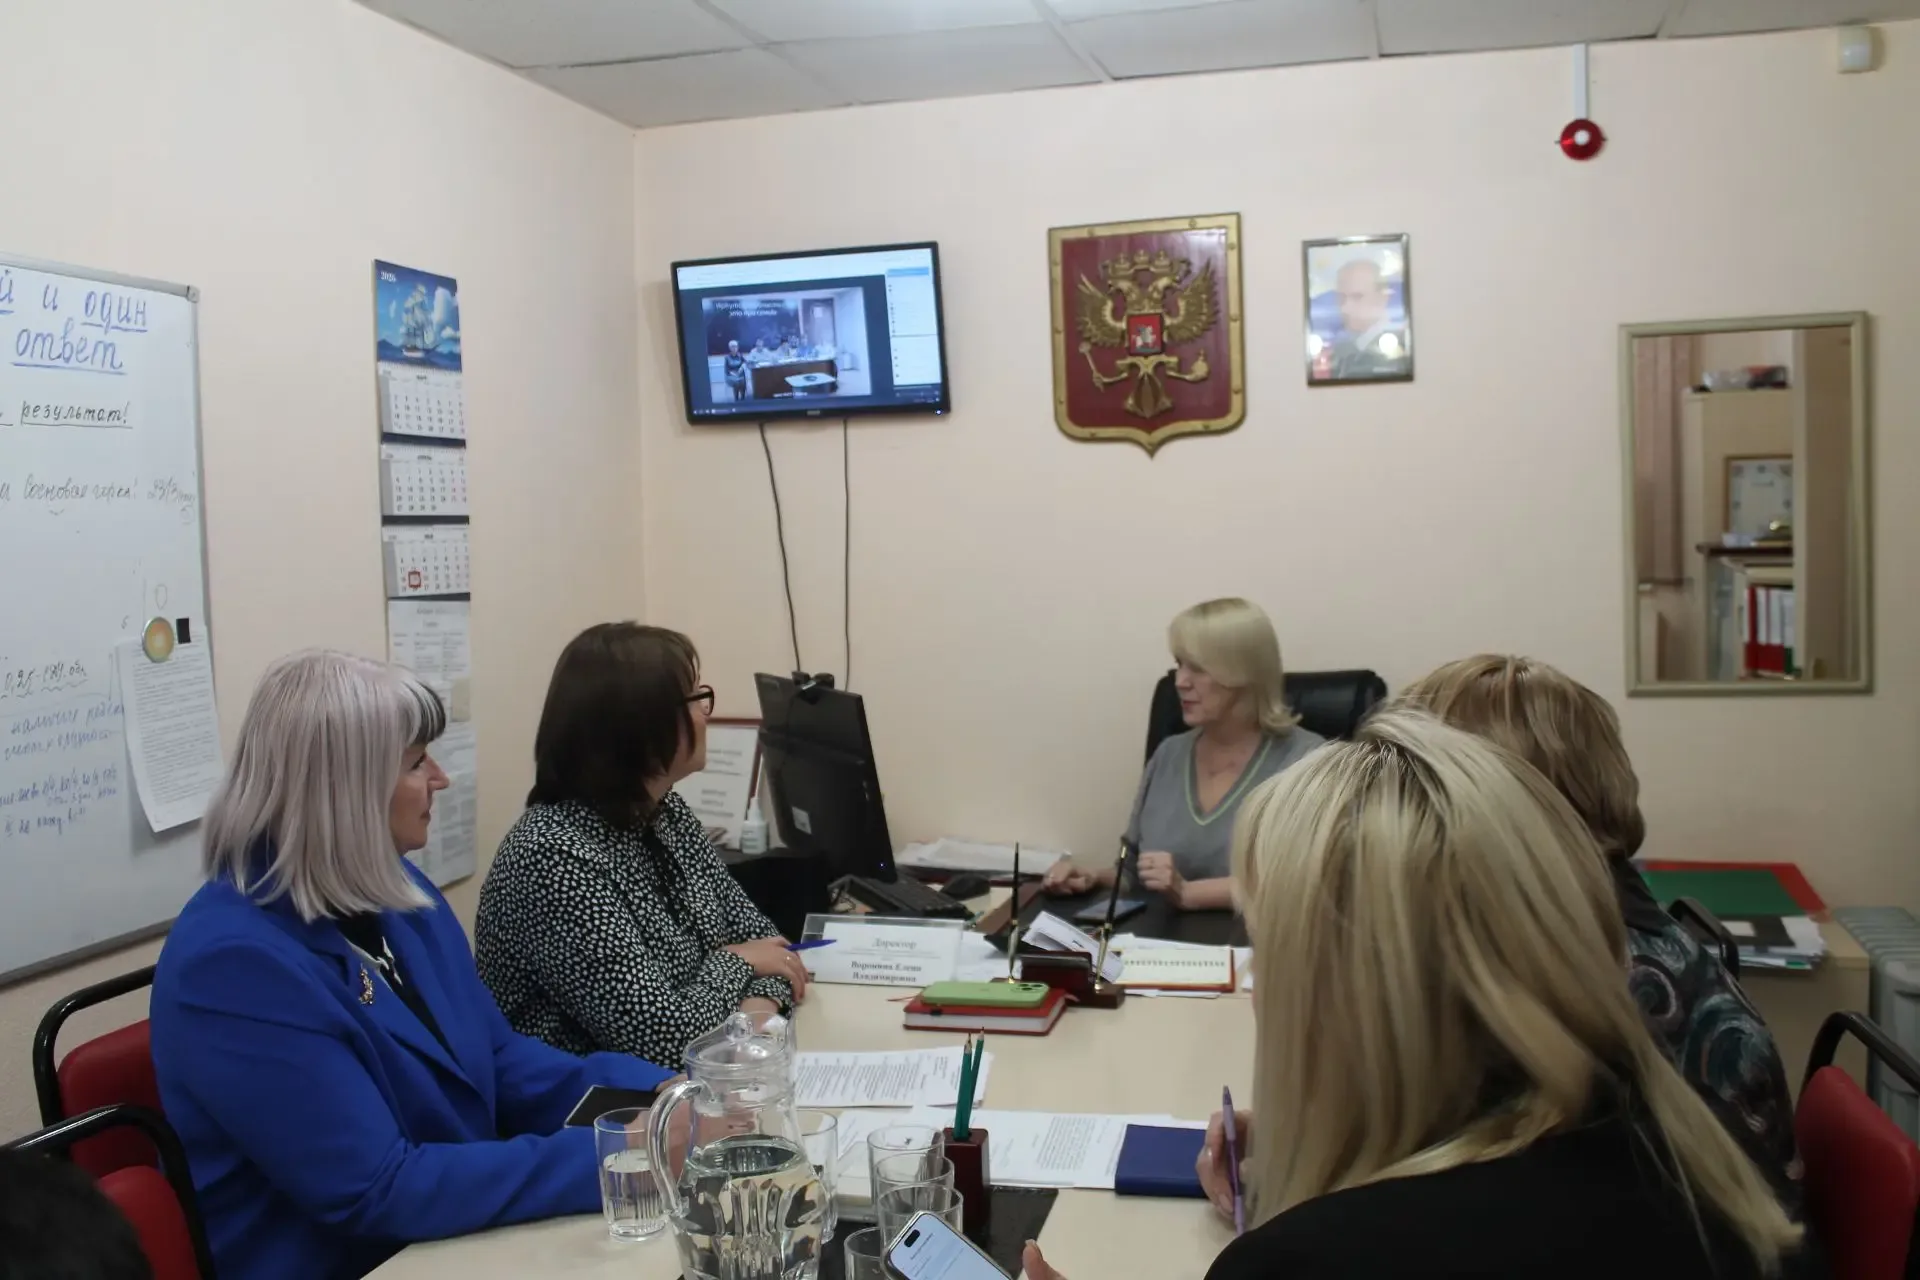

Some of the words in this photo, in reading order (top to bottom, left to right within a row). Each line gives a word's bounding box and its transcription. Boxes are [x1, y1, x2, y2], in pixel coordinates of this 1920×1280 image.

[42, 283, 59, 311] и
[84, 290, 147, 334] один
[16, 316, 123, 370] ответ
[20, 400, 131, 425] результат!
